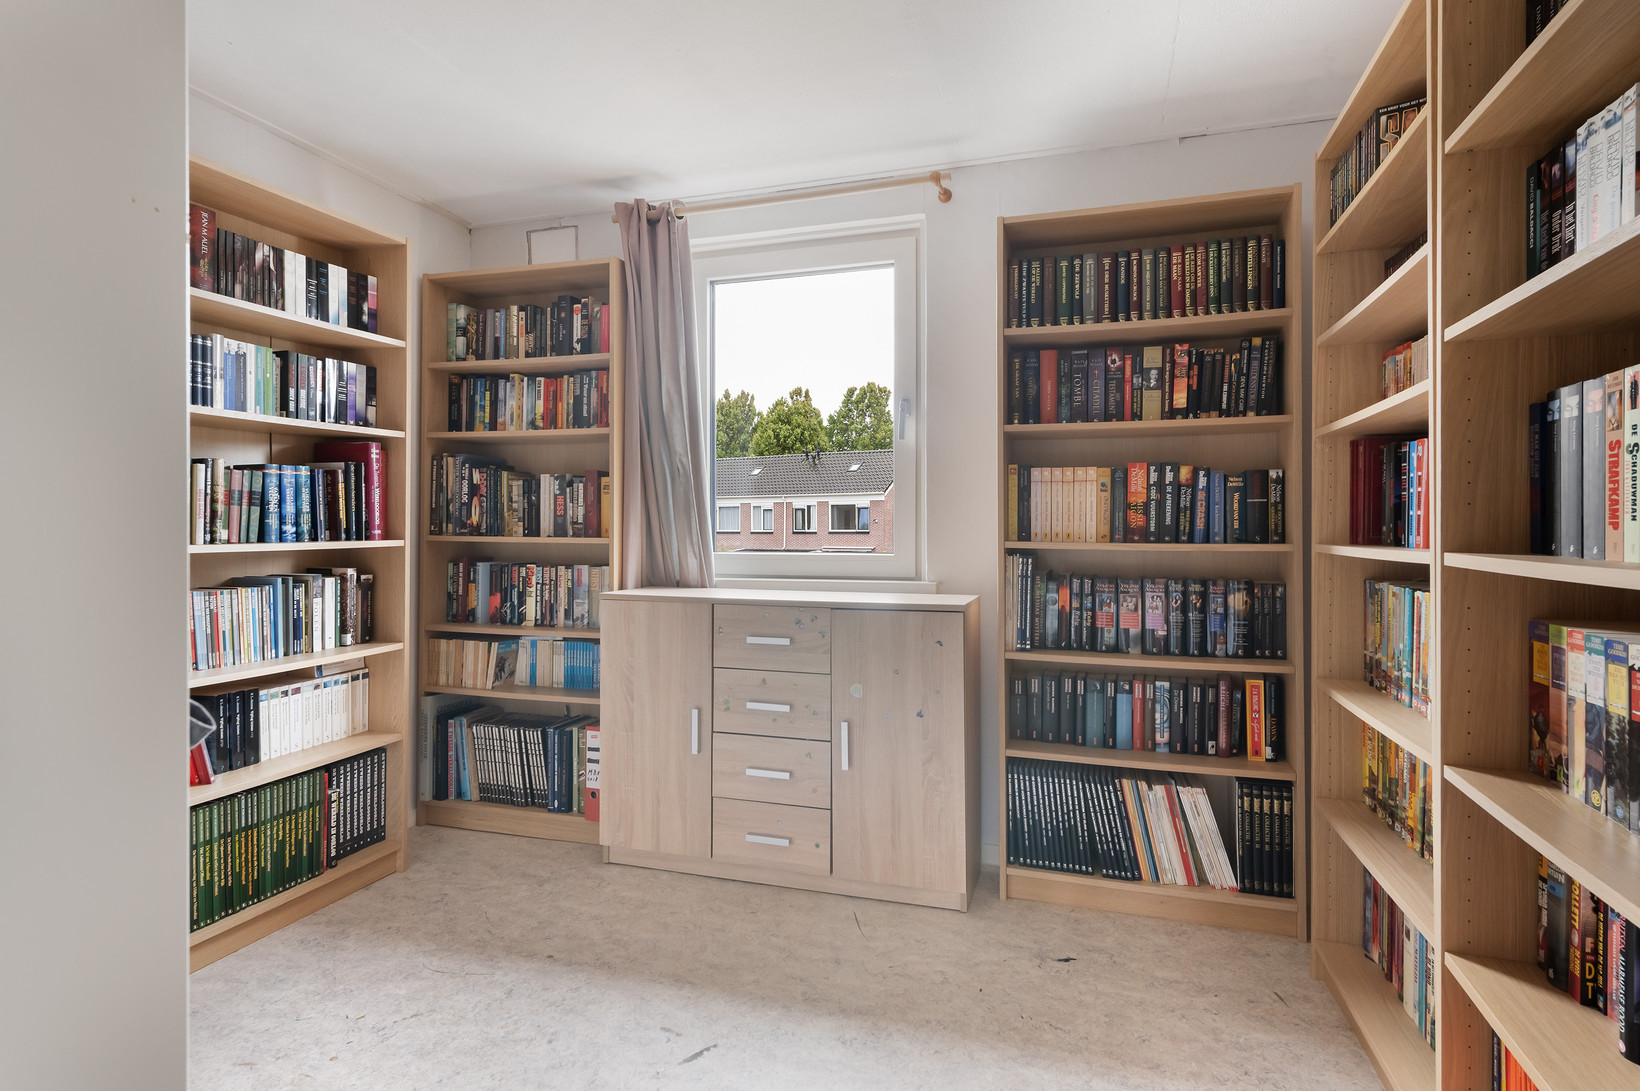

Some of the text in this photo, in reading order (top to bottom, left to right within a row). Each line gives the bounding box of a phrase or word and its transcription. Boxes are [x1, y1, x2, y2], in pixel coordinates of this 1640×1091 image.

[1595, 142, 1603, 185] DAVID
[1611, 130, 1620, 177] DAVID
[1551, 209, 1561, 254] Onder Druk
[1565, 224, 1575, 243] Hart
[1073, 373, 1082, 407] TOMBE
[1092, 379, 1101, 415] CITADEL
[1108, 380, 1116, 414] TESTAMENT
[1238, 375, 1246, 411] DEVIL MAY CARE
[1631, 424, 1638, 436] DE
[1165, 485, 1172, 493] DE
[1608, 439, 1622, 531] STRAFKAMP
[1626, 442, 1639, 522] SCHADUWMAN
[556, 495, 564, 515] HESS
[1197, 490, 1206, 529] de CRASH
[590, 569, 599, 592] KIRST
[339, 766, 344, 774] DE
[353, 761, 358, 769] DE
[366, 757, 371, 765] DE
[373, 755, 378, 763] DE
[330, 793, 337, 801] DE
[1597, 956, 1604, 964] DE
